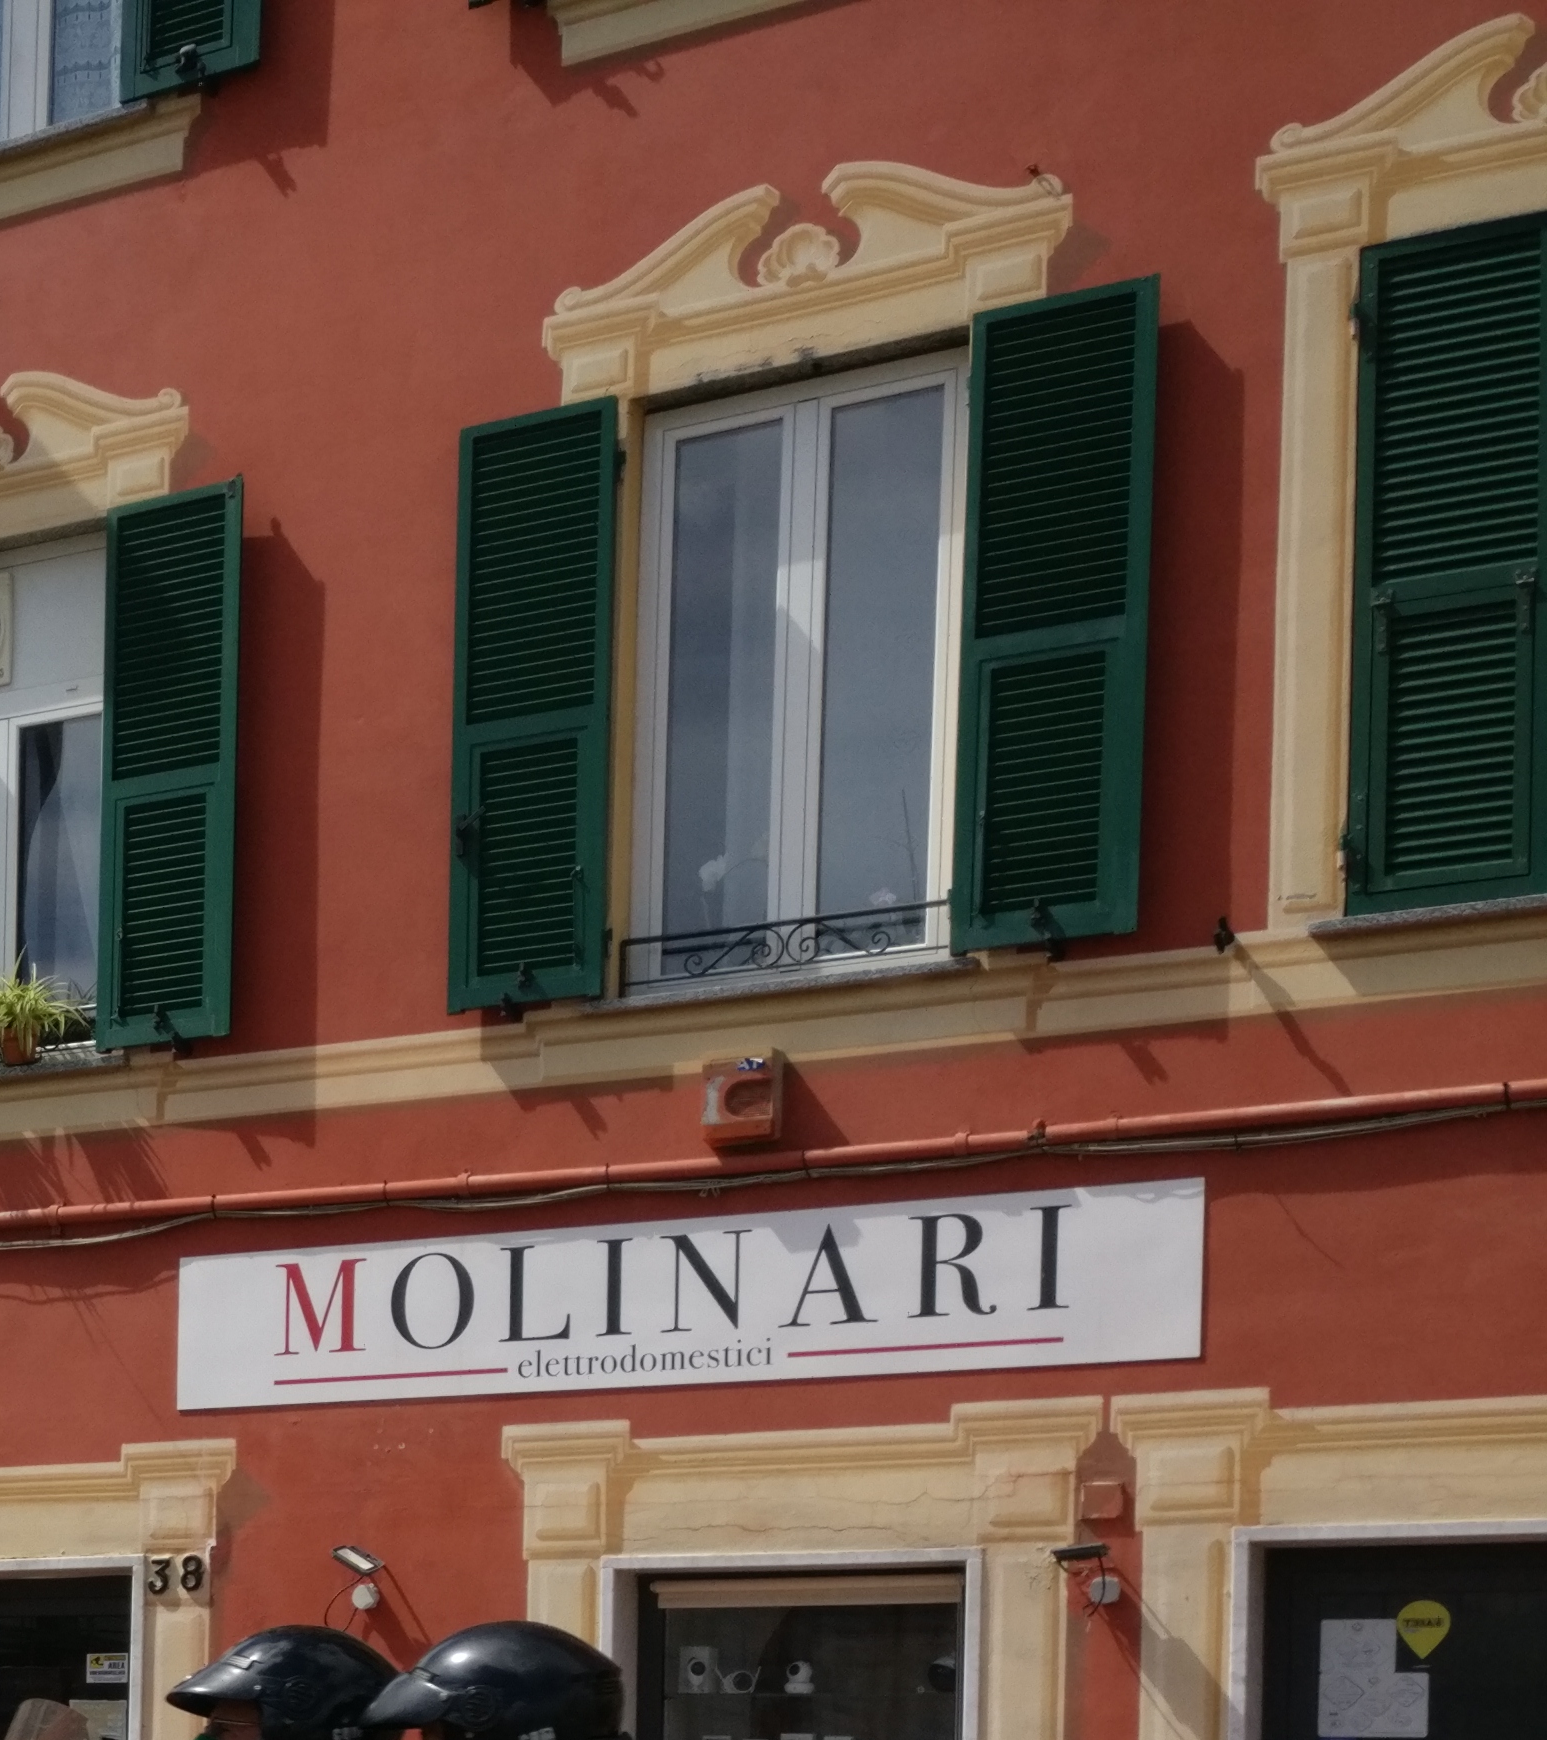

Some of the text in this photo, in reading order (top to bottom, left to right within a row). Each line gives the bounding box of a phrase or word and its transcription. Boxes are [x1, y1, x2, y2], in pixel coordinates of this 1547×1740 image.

[273, 1204, 1072, 1356] MOLINARI
[516, 1338, 774, 1379] elettrodomestici
[148, 1555, 203, 1595] 38
